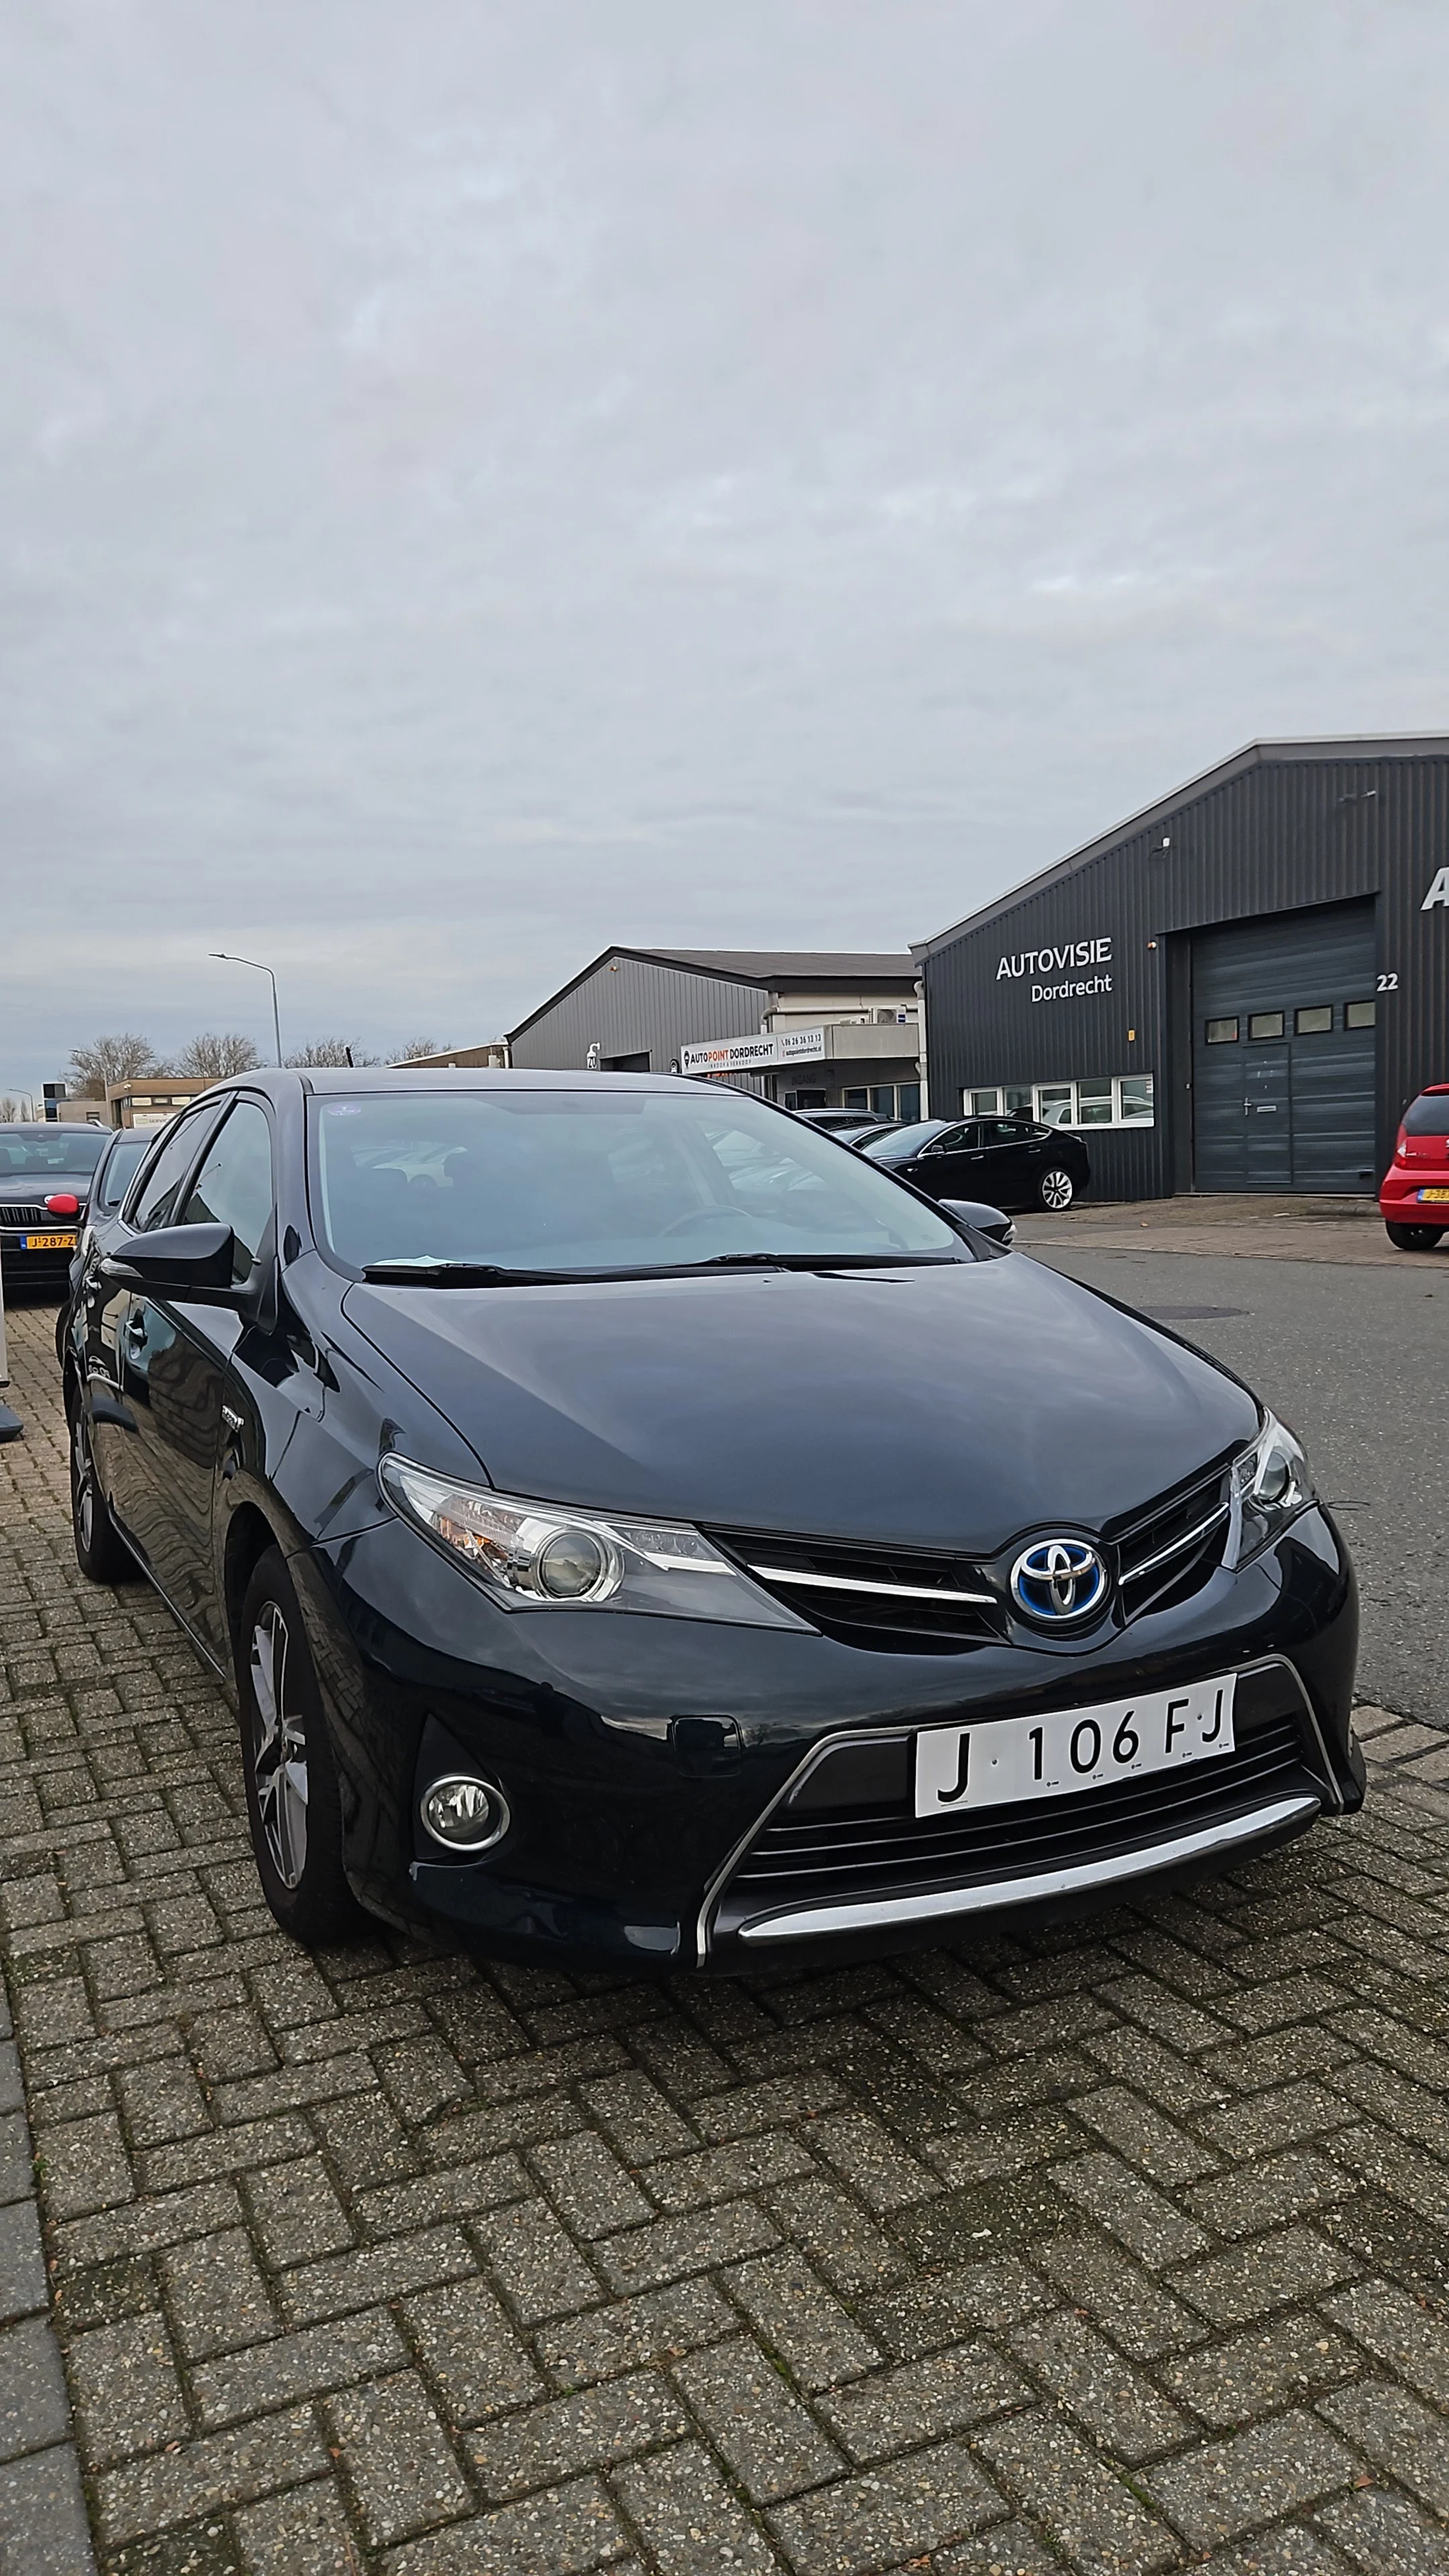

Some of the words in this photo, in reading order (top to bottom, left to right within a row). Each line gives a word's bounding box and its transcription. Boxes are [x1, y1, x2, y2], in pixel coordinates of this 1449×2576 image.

[996, 936, 1112, 981] AUTOVISIE
[1031, 974, 1112, 1002] Dordrecht
[1377, 973, 1399, 992] 22
[808, 1034, 814, 1043] 13
[815, 1034, 821, 1042] 13
[690, 1049, 729, 1064] AUTOPOINT
[729, 1044, 774, 1059] DORDRECHT
[32, 1236, 76, 1248] J-287-Z
[937, 1732, 971, 1803] J
[1028, 1710, 1139, 1780] 106
[1165, 1688, 1224, 1754] FJ
